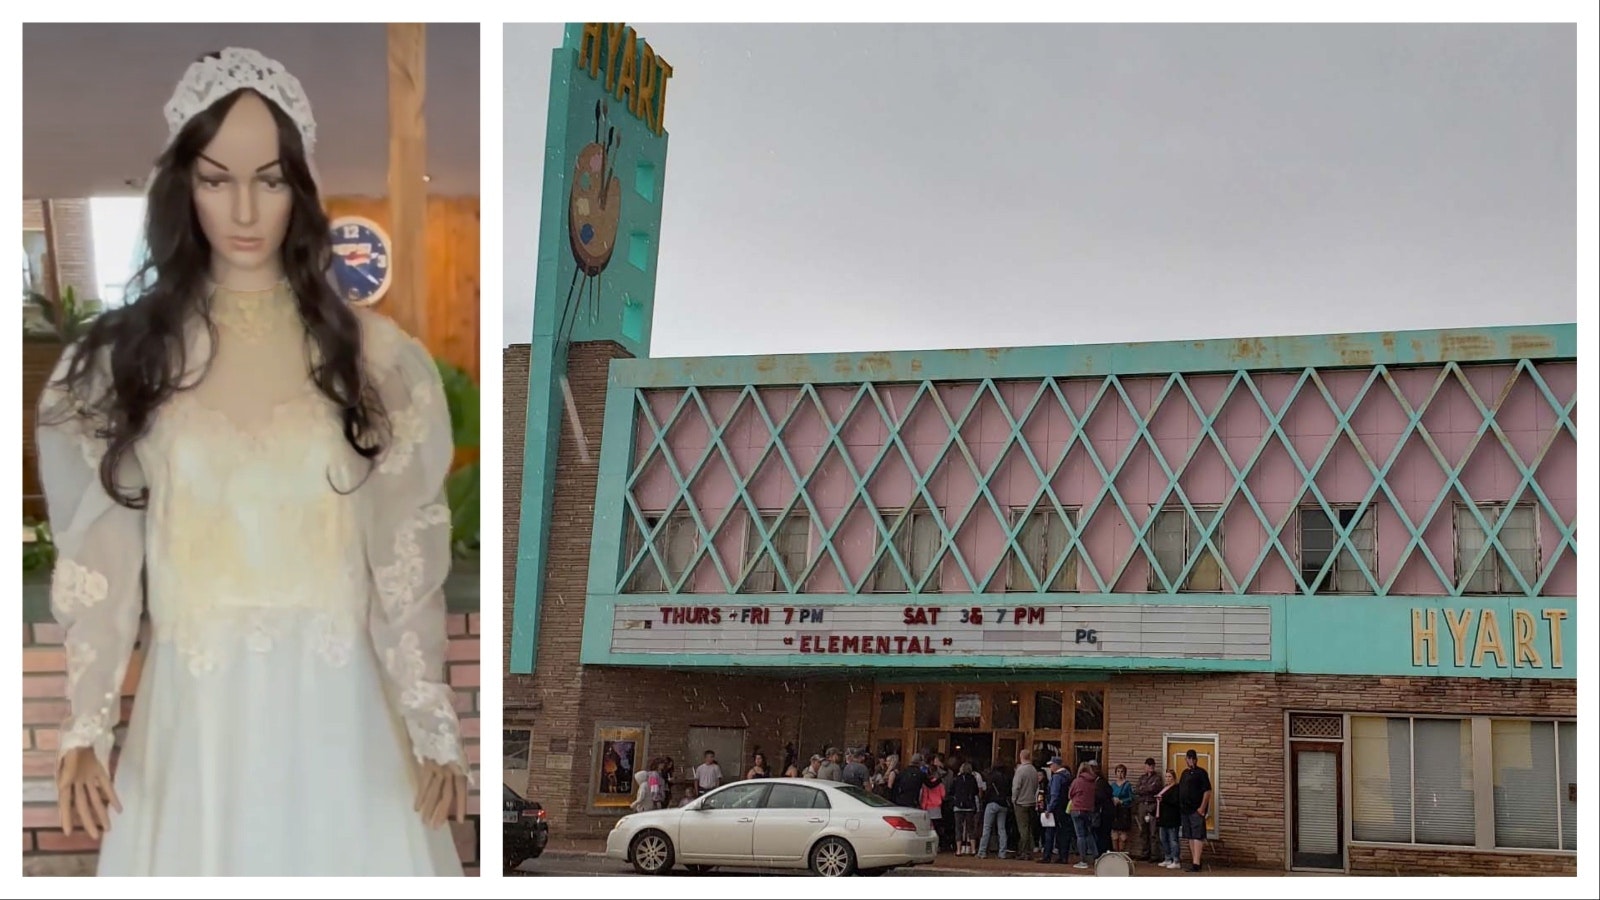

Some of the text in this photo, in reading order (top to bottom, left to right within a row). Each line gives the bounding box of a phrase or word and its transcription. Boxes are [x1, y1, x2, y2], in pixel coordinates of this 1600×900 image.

[578, 22, 673, 138] HYART
[344, 226, 359, 239] 12
[660, 607, 721, 624] THURS
[741, 607, 770, 624] FRI
[783, 607, 794, 624] 7
[799, 608, 824, 623] PM
[904, 607, 941, 625] SAT
[995, 608, 1008, 624] 7
[1014, 607, 1046, 625] PM
[1075, 628, 1097, 644] PG
[1411, 608, 1567, 668] HYART
